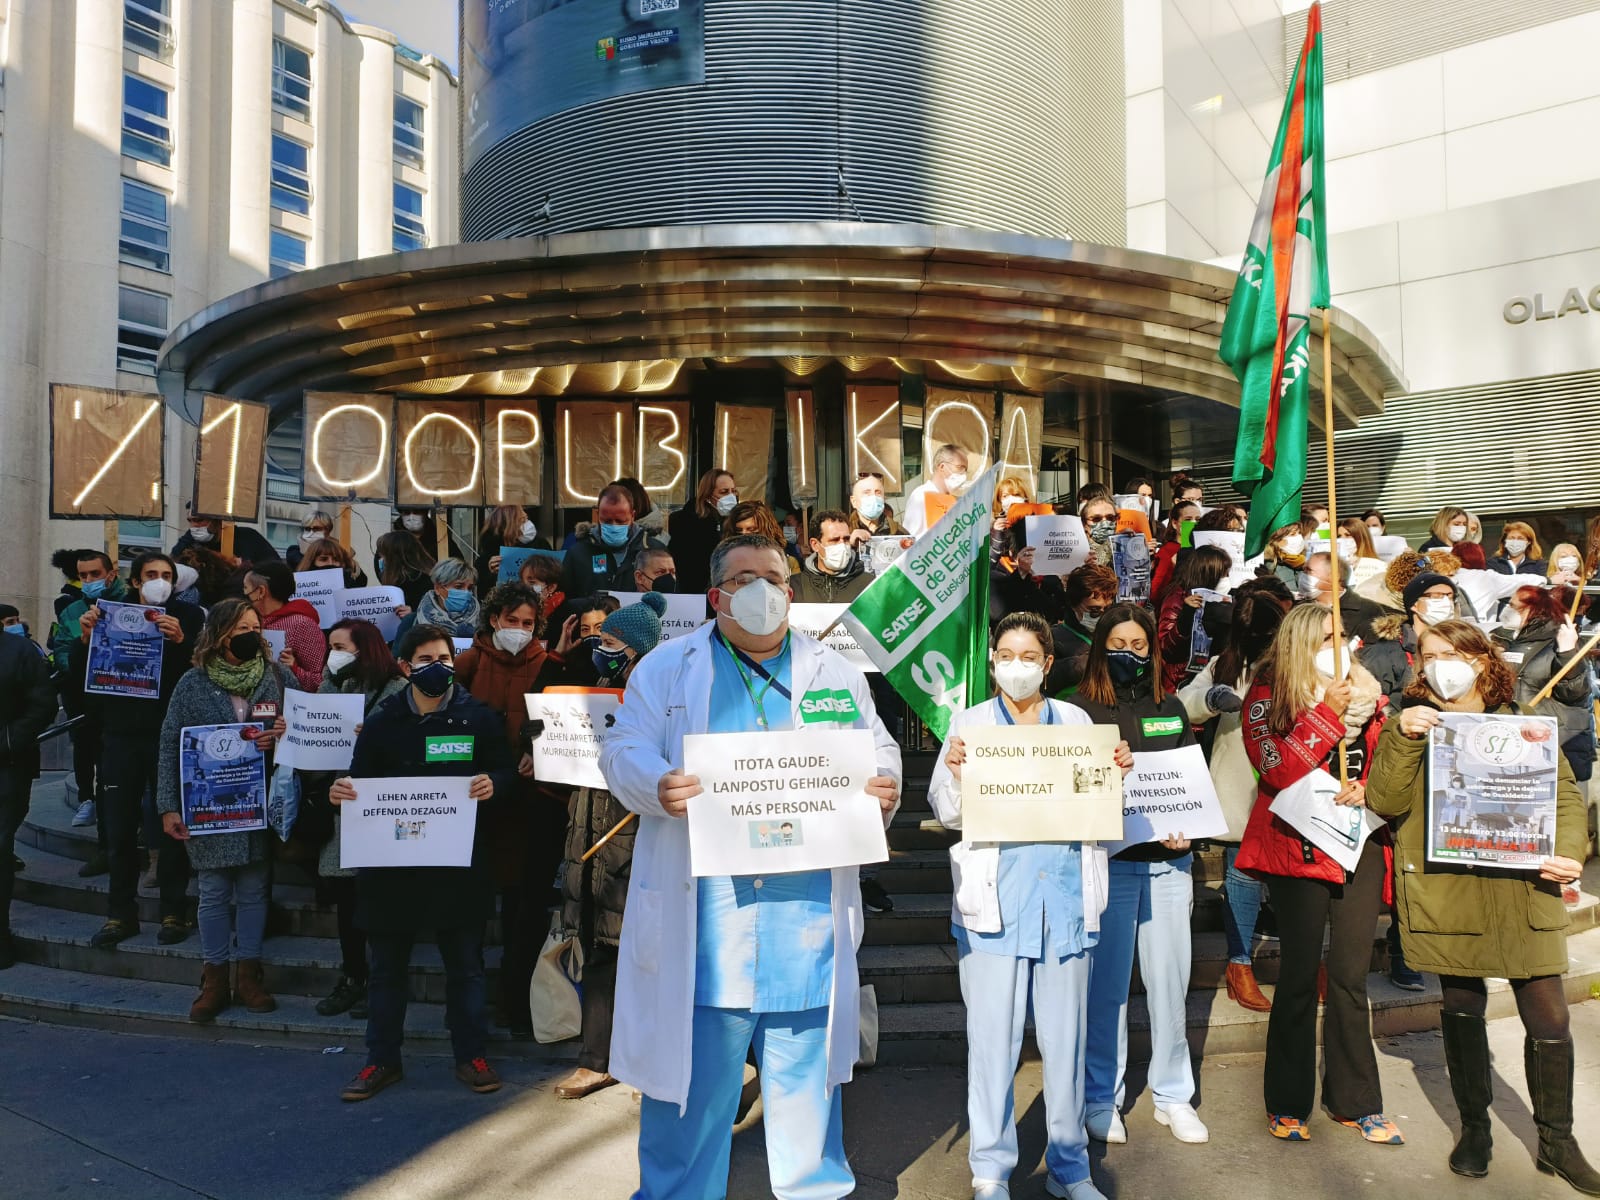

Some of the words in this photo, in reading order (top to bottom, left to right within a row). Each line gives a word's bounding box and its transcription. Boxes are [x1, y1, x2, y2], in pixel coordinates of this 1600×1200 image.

[926, 568, 946, 591] de
[942, 534, 972, 573] Enfe
[683, 620, 695, 628] EN
[881, 597, 927, 644] SATSE
[253, 704, 275, 713] LAB
[801, 698, 855, 713] SATSE
[1143, 720, 1183, 732] SATSE
[301, 738, 352, 748] IMPOSICIÓN
[428, 742, 473, 754] SATSE
[975, 746, 1025, 758] OSASUN
[1032, 745, 1092, 757] PUBLIKOA
[734, 757, 774, 771] ITOTA
[777, 755, 830, 769] GAUDE:
[1138, 771, 1183, 782] ENTZUN:
[713, 778, 785, 793] LANPOSTU
[788, 775, 850, 790] GEHIAGO
[980, 783, 1054, 795] DENONTZAT
[377, 793, 408, 802] LEHEN
[410, 792, 448, 801] ARRETA
[1130, 786, 1186, 798] INVERSION
[363, 807, 408, 817] DEFENDA
[411, 806, 457, 816] DEZAGUN
[731, 801, 762, 817] MÁS
[766, 800, 836, 815] PERSONAL
[1138, 799, 1203, 814] IMPOSICIÓN
[1450, 826, 1462, 834] de
